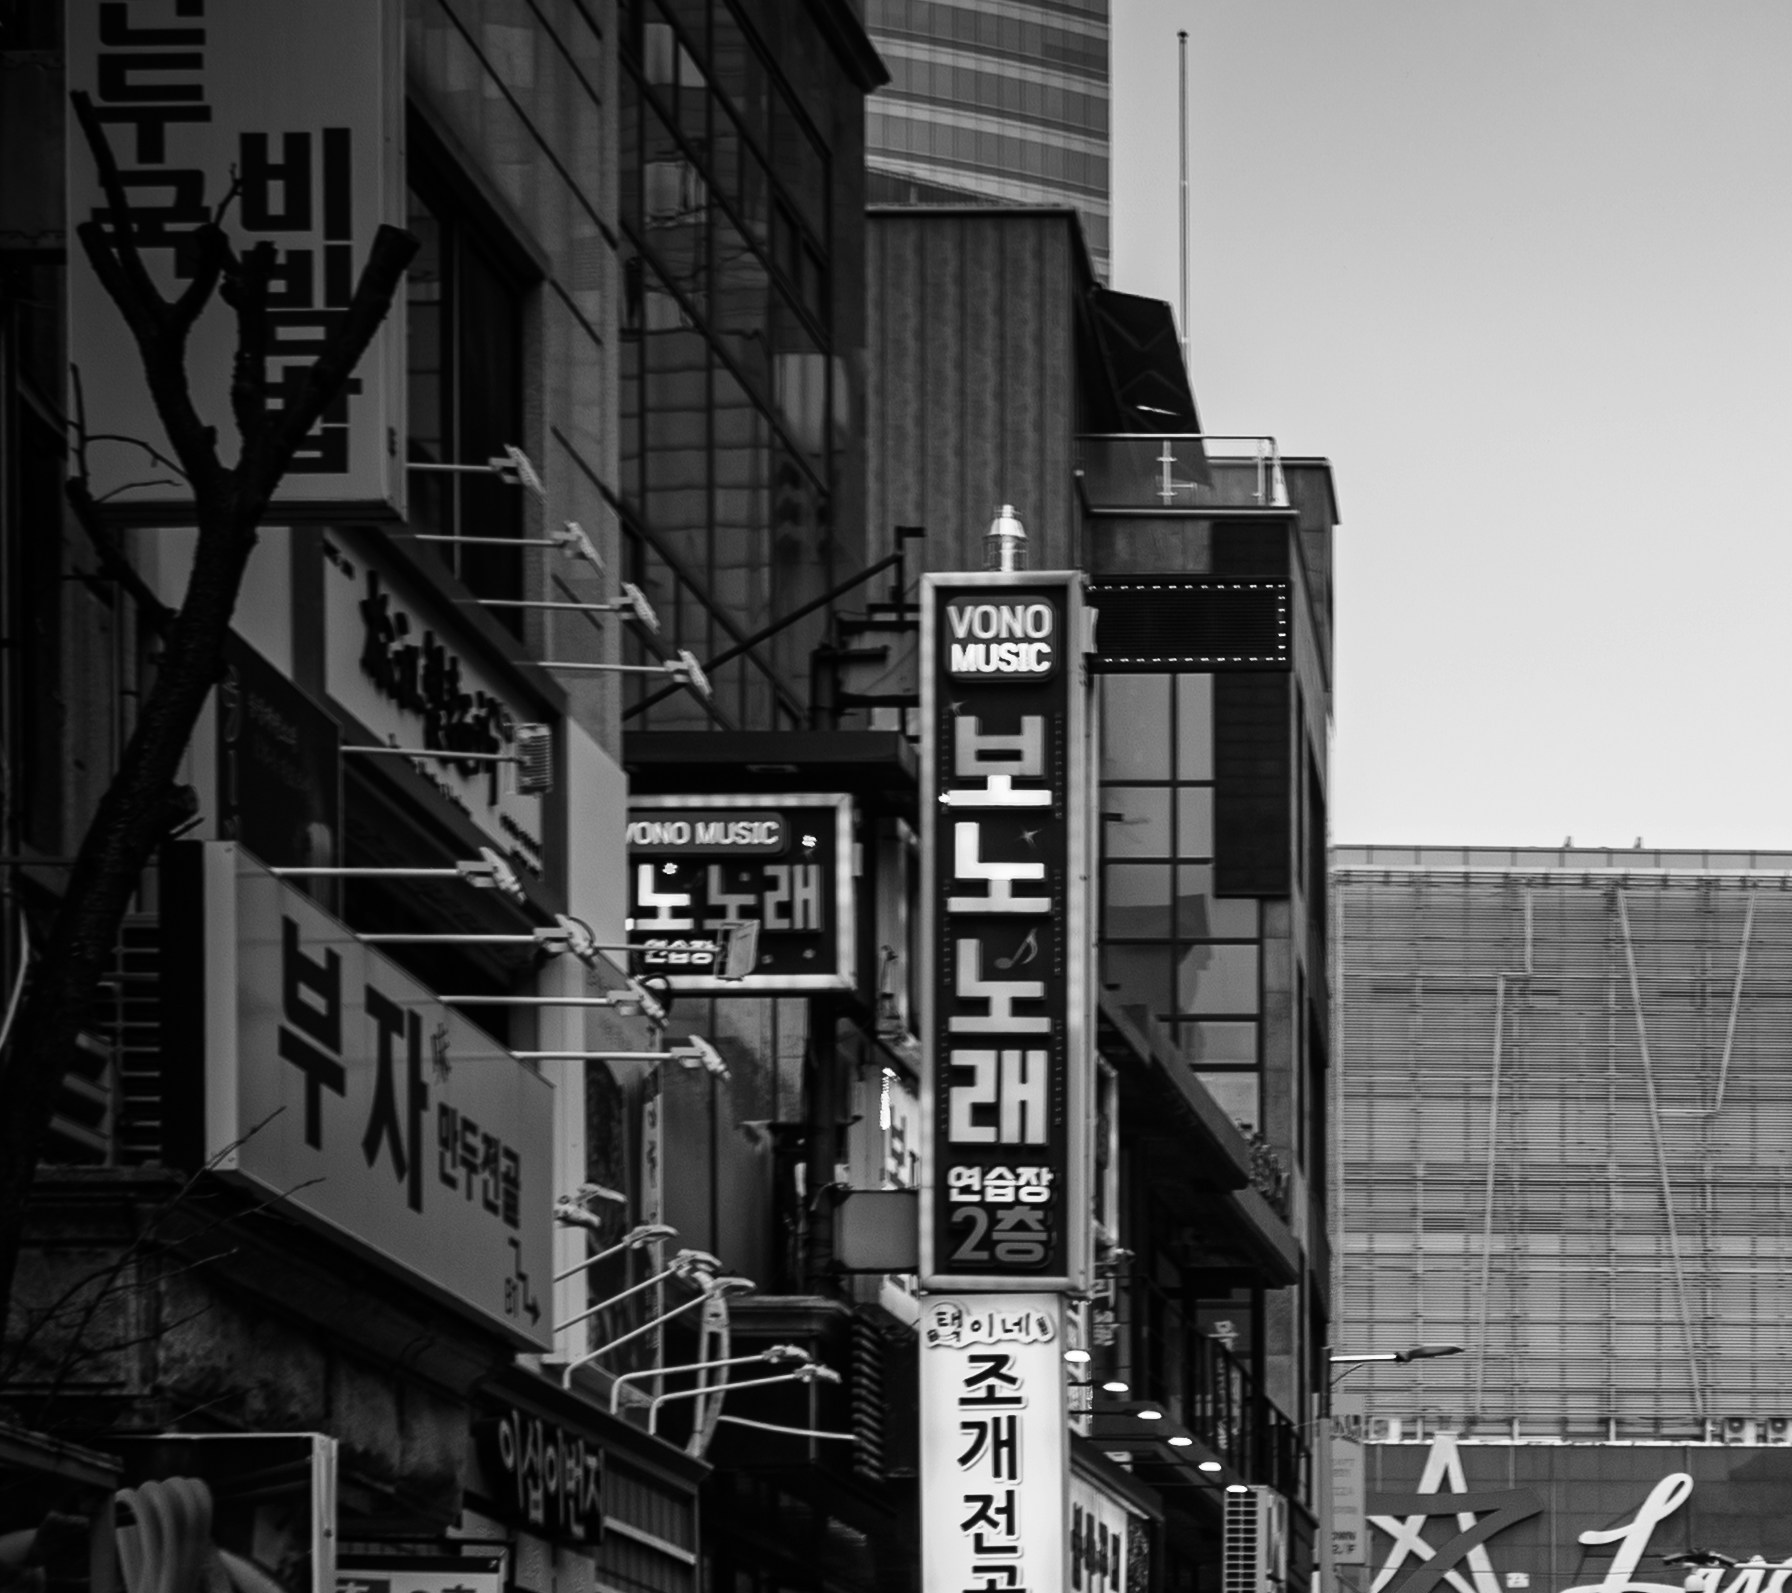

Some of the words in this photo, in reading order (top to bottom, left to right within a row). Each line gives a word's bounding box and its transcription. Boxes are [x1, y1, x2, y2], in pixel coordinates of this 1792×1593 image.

[91, 0, 211, 278] 두국
[946, 604, 1053, 639] VONO
[950, 642, 1053, 673] MUSIC
[695, 821, 780, 845] MUSIC
[626, 863, 824, 931] 노노래
[944, 714, 1054, 1147] 보노노래
[278, 914, 429, 1215] 부자
[438, 1102, 521, 1231] 만두전골
[946, 1165, 1054, 1203] 연습장
[949, 1205, 1051, 1265] 2층
